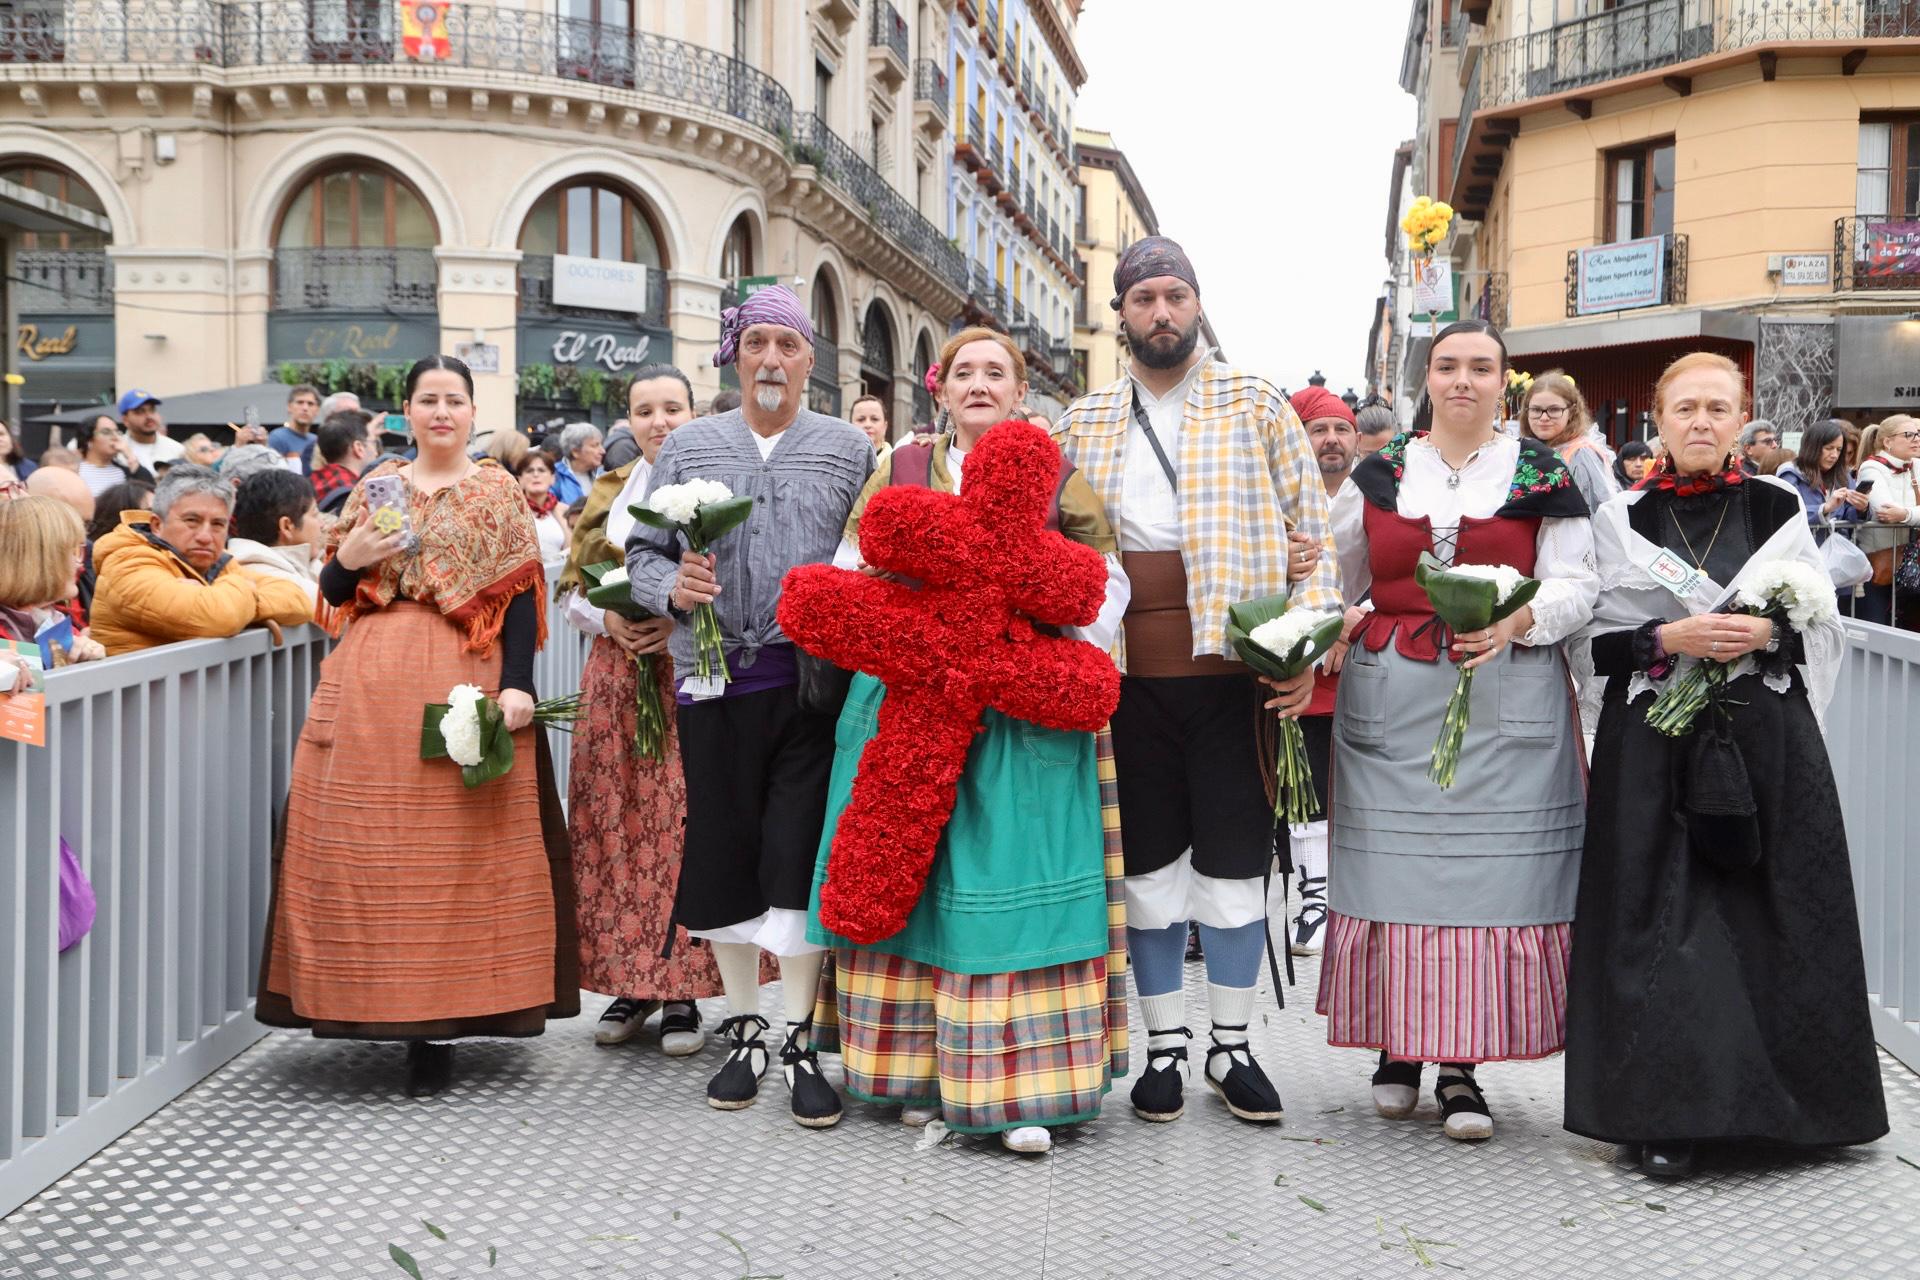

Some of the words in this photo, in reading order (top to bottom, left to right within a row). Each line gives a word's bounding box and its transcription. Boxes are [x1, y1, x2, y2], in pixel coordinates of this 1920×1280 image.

[1886, 233, 1904, 243] Las
[1613, 253, 1647, 263] Abogados
[1880, 246, 1893, 256] de
[568, 263, 635, 281] DOCTORES
[1613, 271, 1633, 280] Sport
[1634, 267, 1654, 276] Legal
[17, 324, 77, 360] Real
[341, 323, 399, 358] Real
[552, 330, 588, 362] El
[589, 334, 650, 371] Real
[1677, 572, 1700, 594] OFRENDA
[1686, 580, 1701, 594] 2024
